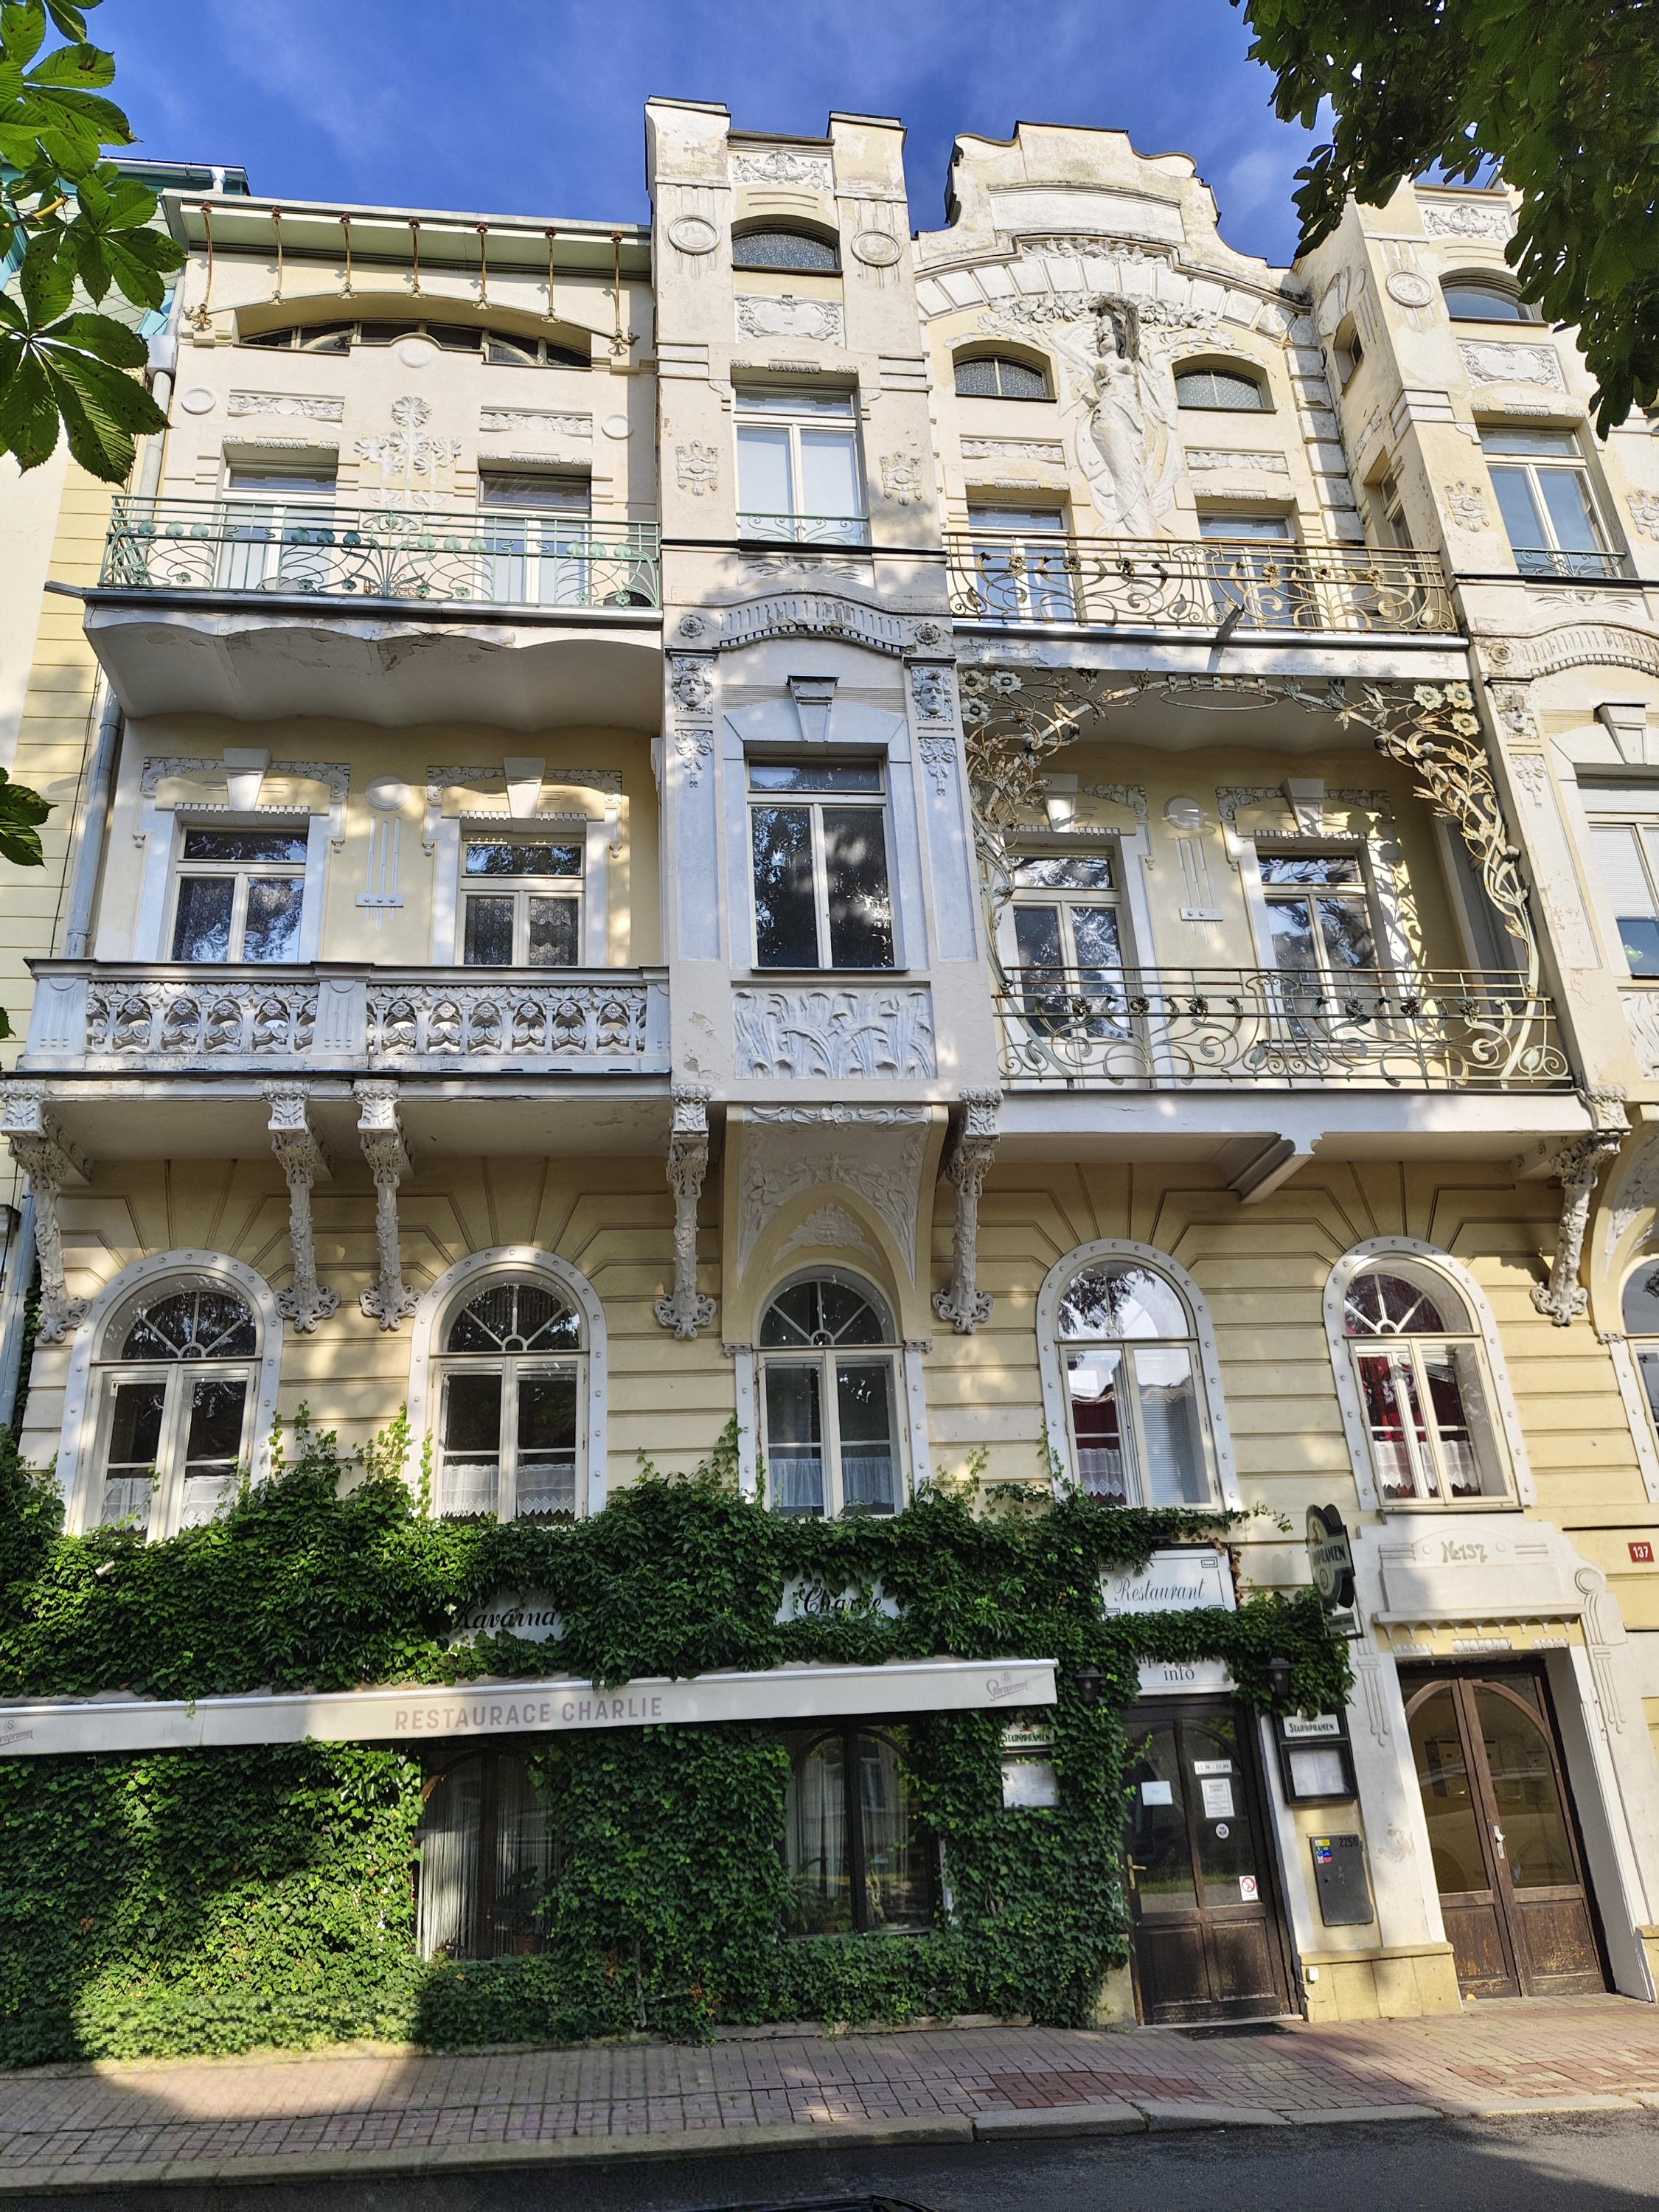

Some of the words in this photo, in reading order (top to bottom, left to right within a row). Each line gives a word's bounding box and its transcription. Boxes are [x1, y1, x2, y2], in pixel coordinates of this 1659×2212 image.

[1632, 1545, 1649, 1558] 137
[1114, 1576, 1205, 1602] Restaurant
[1164, 1665, 1195, 1682] info
[394, 1703, 551, 1731] RESTAURACE
[562, 1697, 662, 1722] CHARLIE
